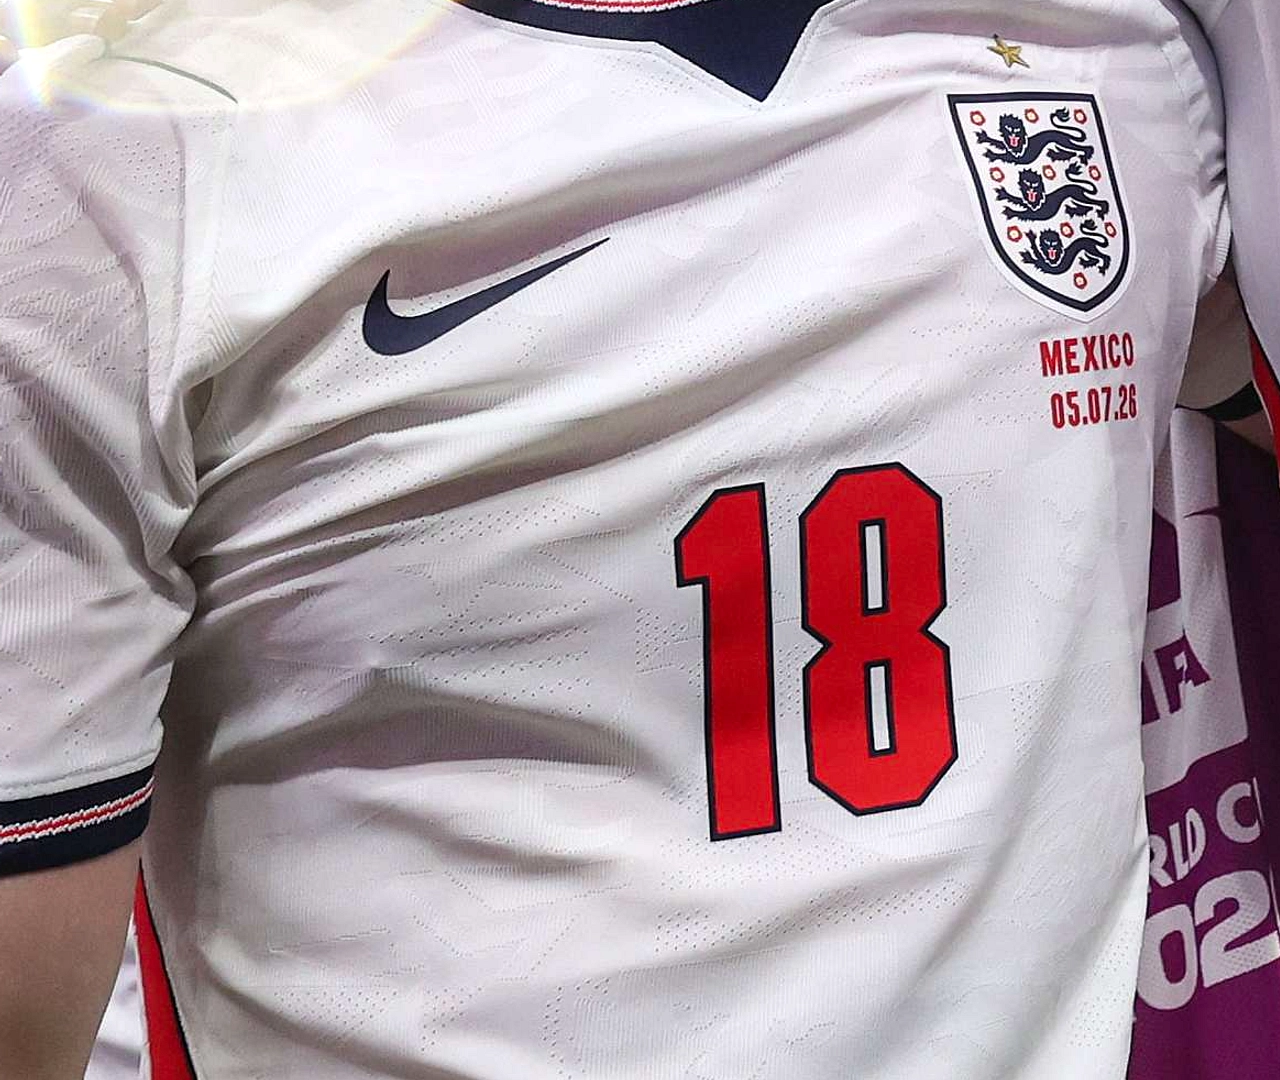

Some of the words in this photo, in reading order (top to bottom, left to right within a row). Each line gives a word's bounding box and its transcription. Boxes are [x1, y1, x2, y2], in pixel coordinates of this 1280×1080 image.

[1040, 332, 1134, 377] MEXICO
[1050, 383, 1137, 429] 05.07.26
[674, 461, 958, 841] 18
[1148, 807, 1206, 888] RLD
